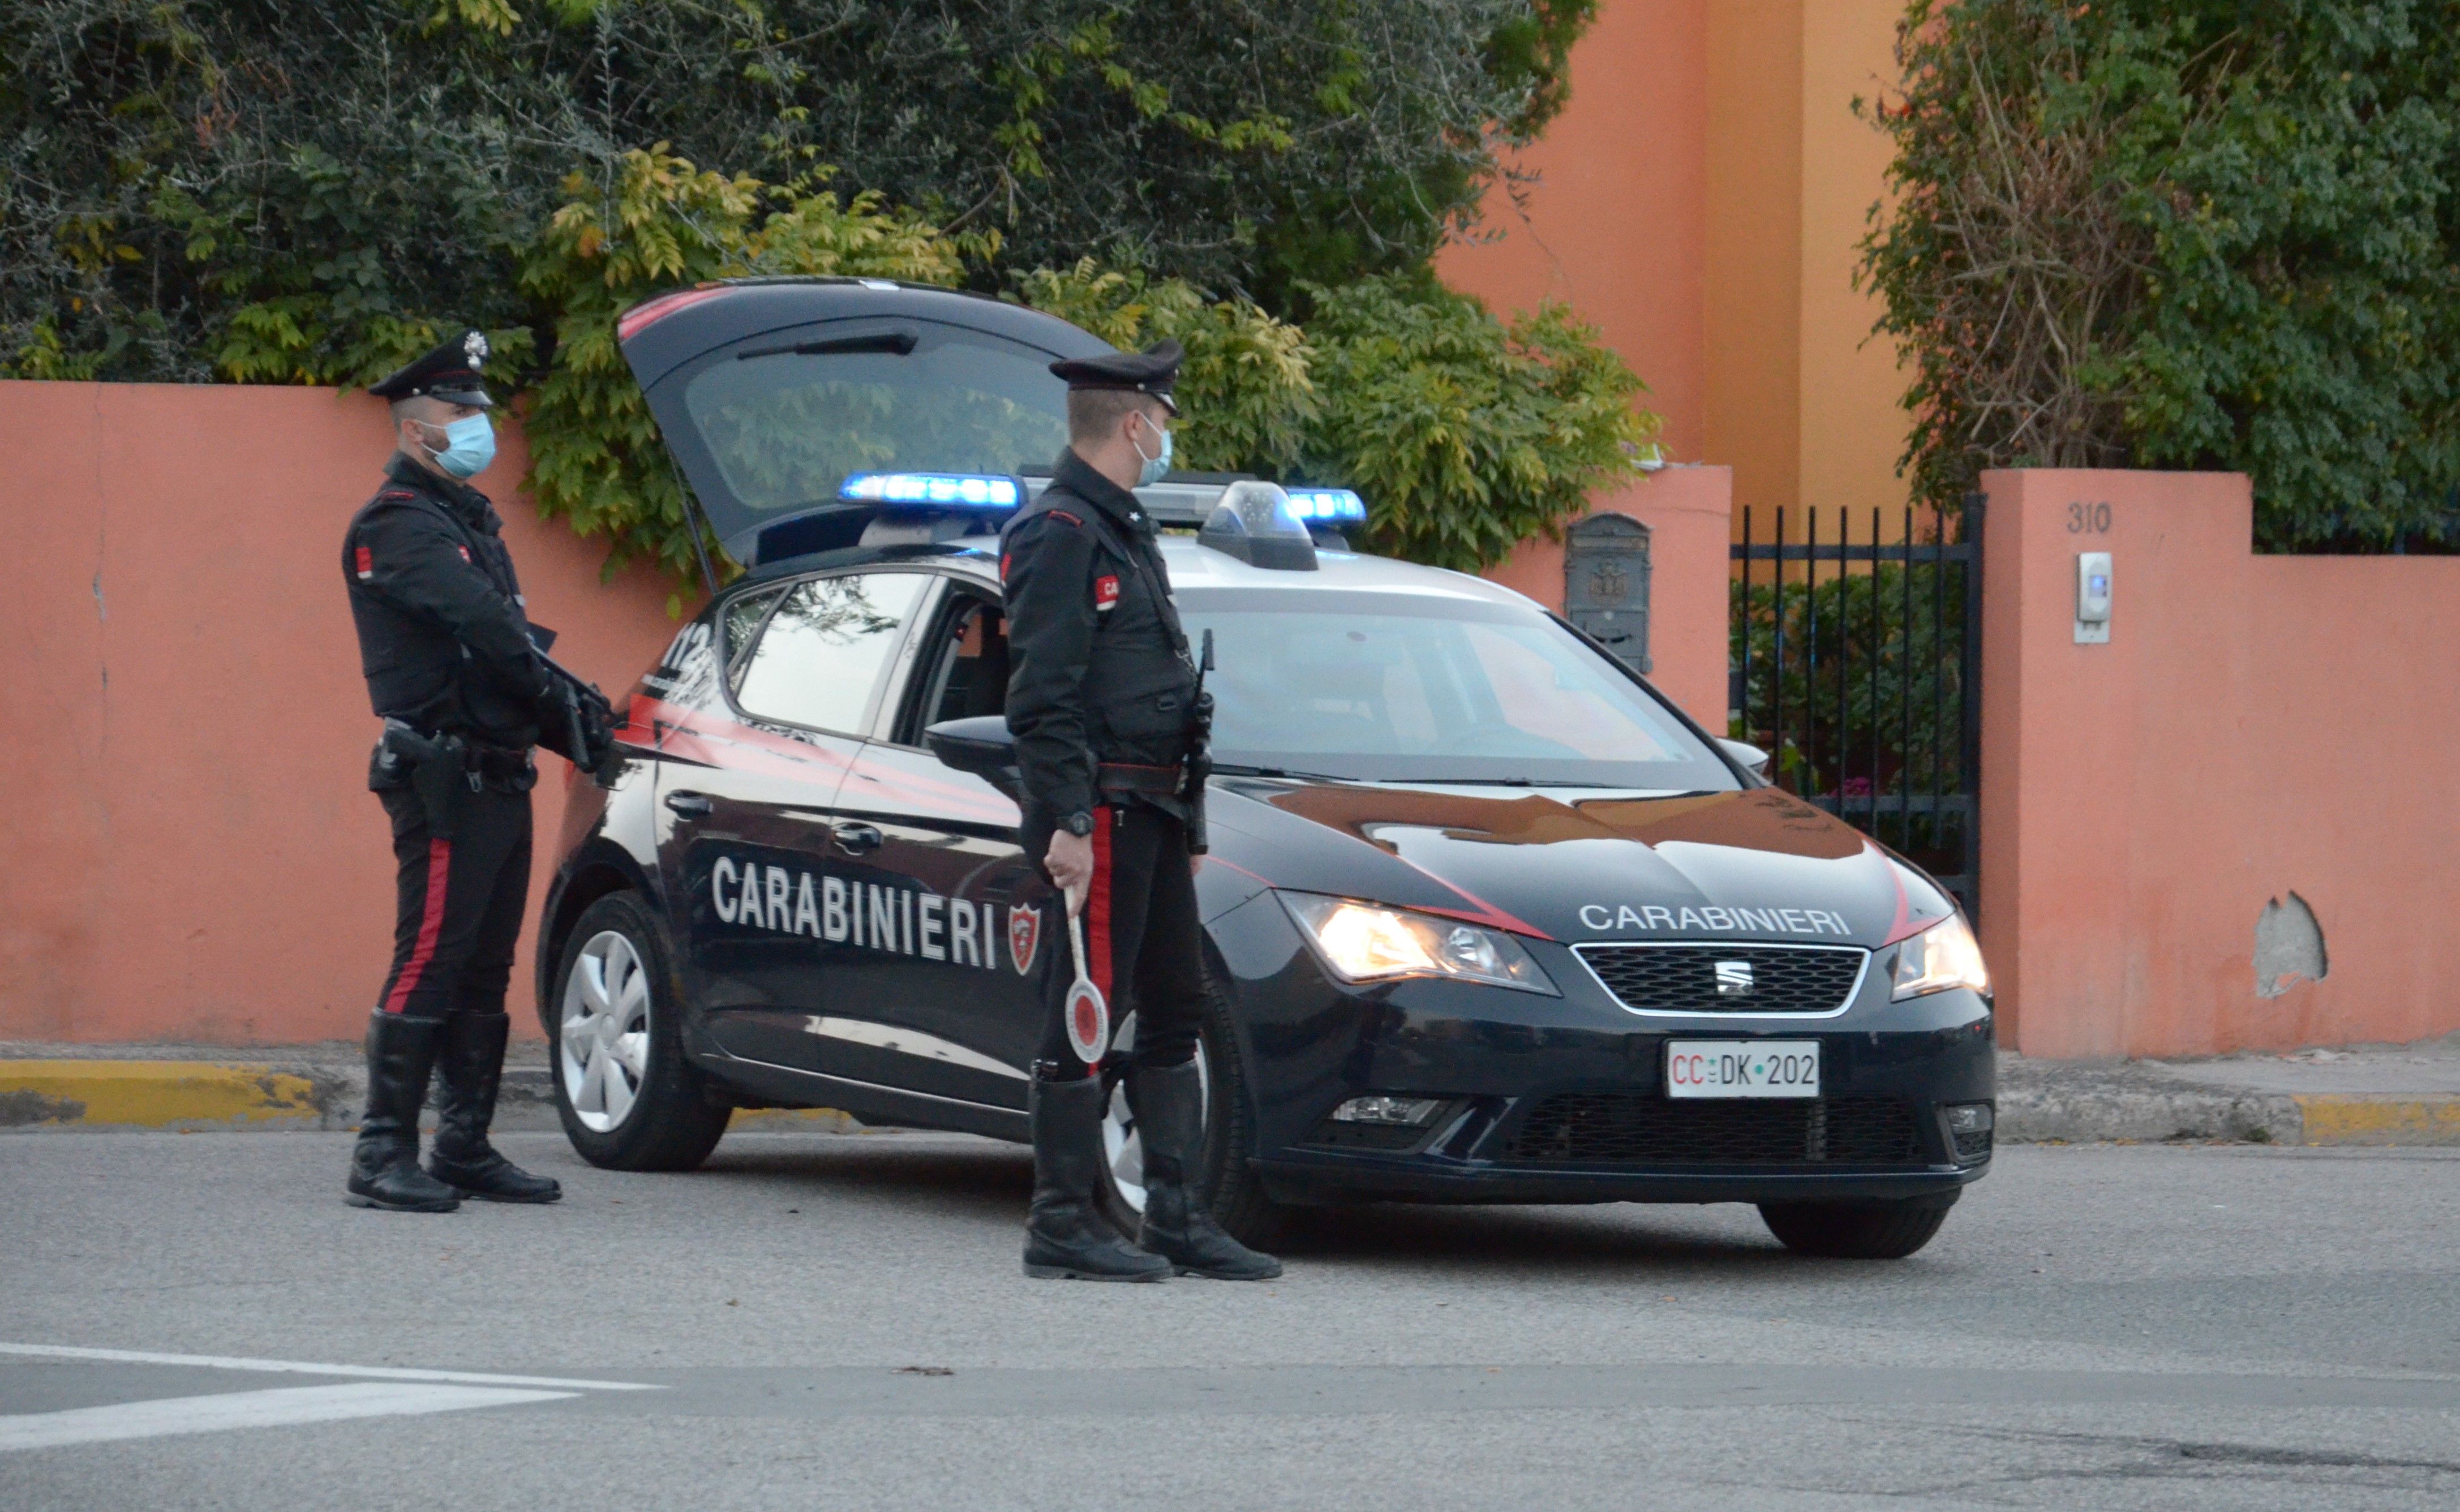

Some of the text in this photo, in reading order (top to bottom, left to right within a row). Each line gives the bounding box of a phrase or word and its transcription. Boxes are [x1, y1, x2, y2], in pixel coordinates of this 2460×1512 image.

[2067, 501, 2111, 534] 310
[660, 622, 711, 672] 112
[712, 856, 996, 969] CARABINIERI
[1579, 905, 1852, 935] CARABINIERI
[1672, 1054, 1814, 1084] CC DK 202
